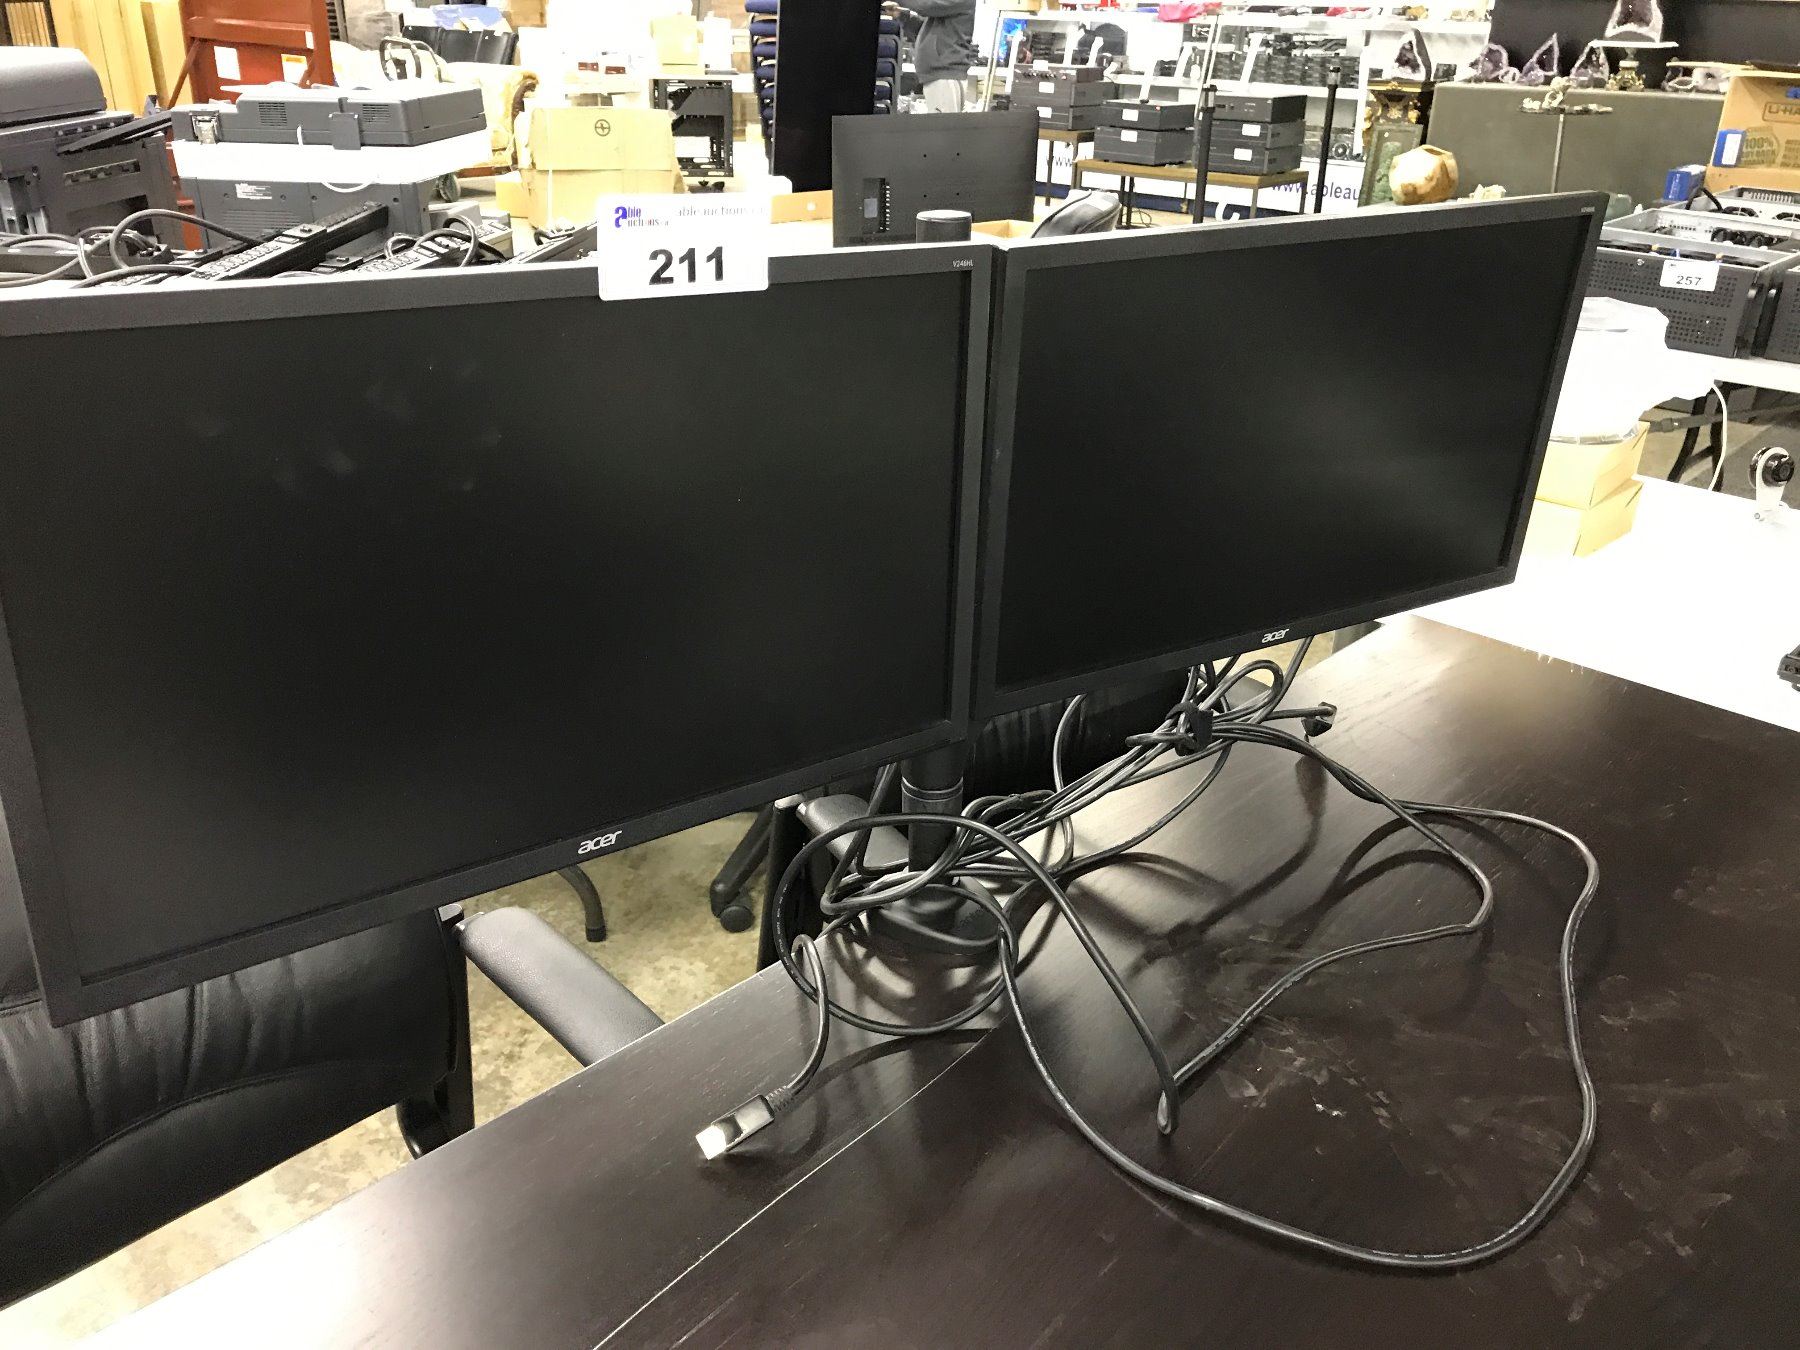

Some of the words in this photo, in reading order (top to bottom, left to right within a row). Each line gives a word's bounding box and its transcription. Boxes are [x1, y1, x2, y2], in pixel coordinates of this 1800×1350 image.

[649, 246, 724, 285] 211
[1676, 275, 1702, 286] 257
[1262, 628, 1290, 643] acer
[578, 830, 622, 854] acer
